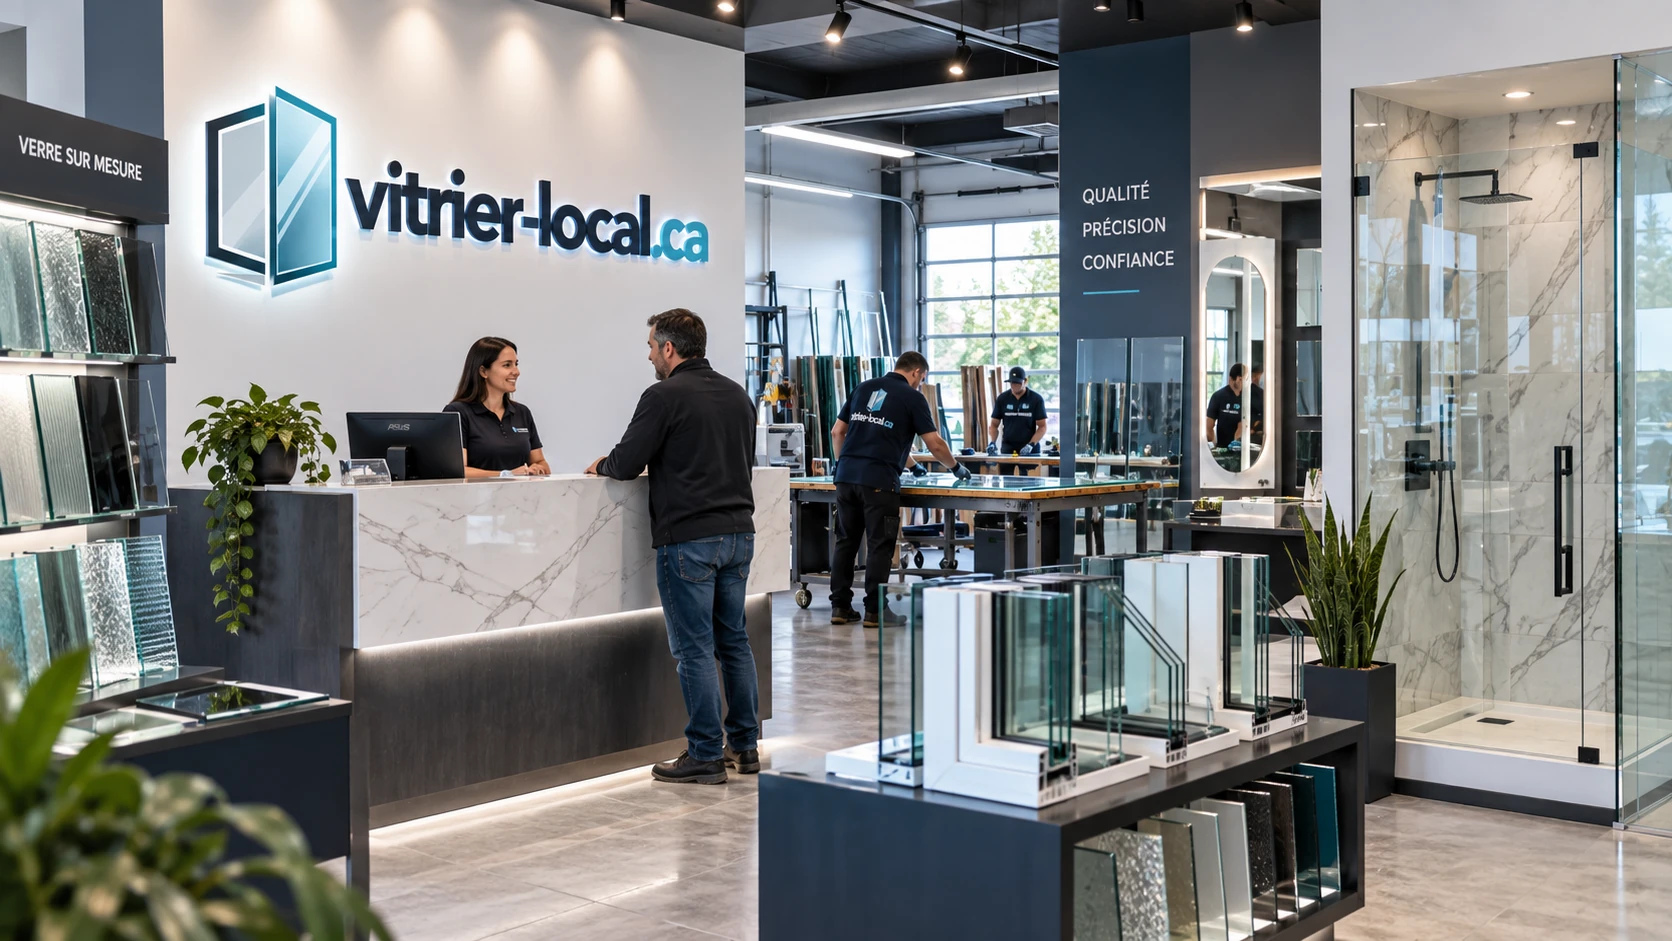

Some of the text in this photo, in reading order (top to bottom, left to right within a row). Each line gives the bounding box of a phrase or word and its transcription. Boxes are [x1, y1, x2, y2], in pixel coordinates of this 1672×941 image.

[18, 135, 143, 181] VERRE SUR MESURE
[1082, 180, 1150, 205] QUALITÉ
[345, 160, 709, 263] vitrier-local.ca
[1082, 217, 1166, 238] PRÉCISION
[1082, 250, 1175, 270] CONFIANCE
[387, 423, 411, 431] ASUS
